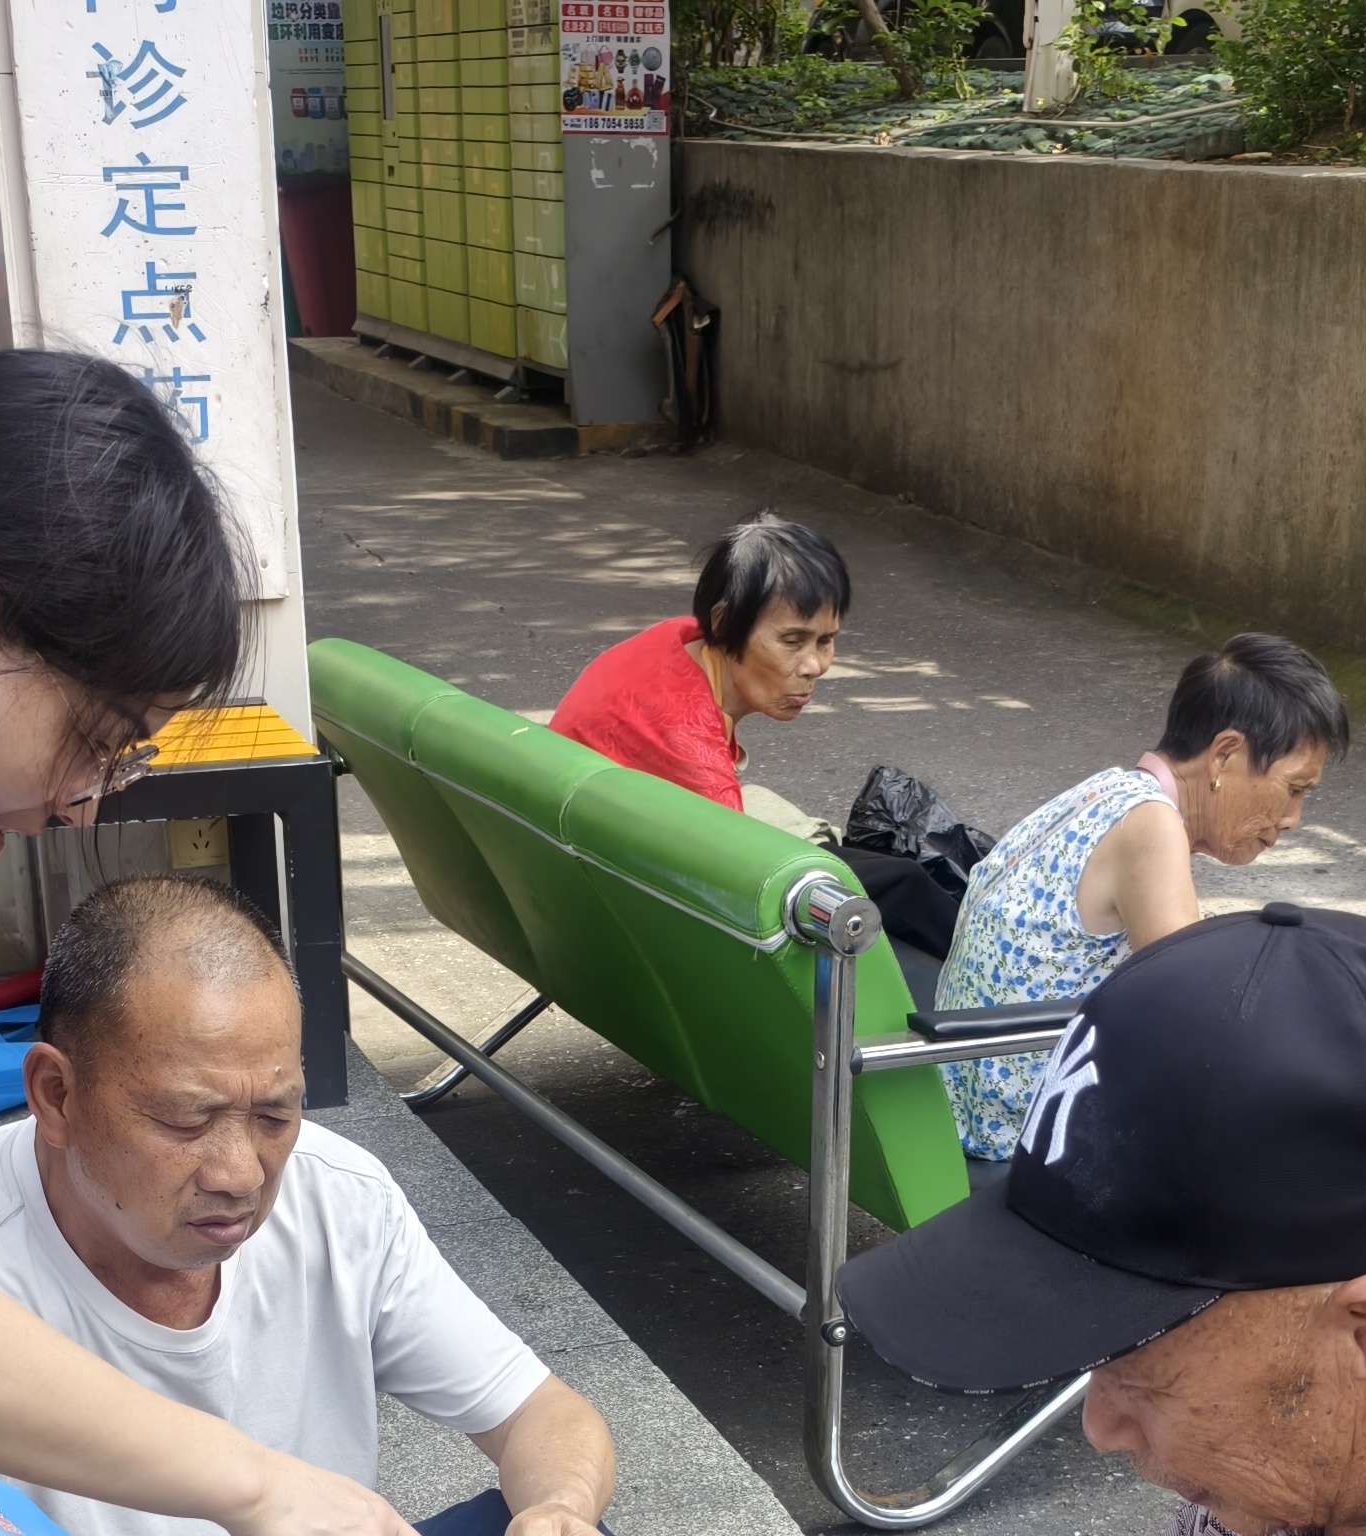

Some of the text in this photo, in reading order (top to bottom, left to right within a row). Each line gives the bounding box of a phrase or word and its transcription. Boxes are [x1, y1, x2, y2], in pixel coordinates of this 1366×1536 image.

[86, 0, 211, 443] 诊定点药
[1099, 780, 1135, 794] LUCKY
